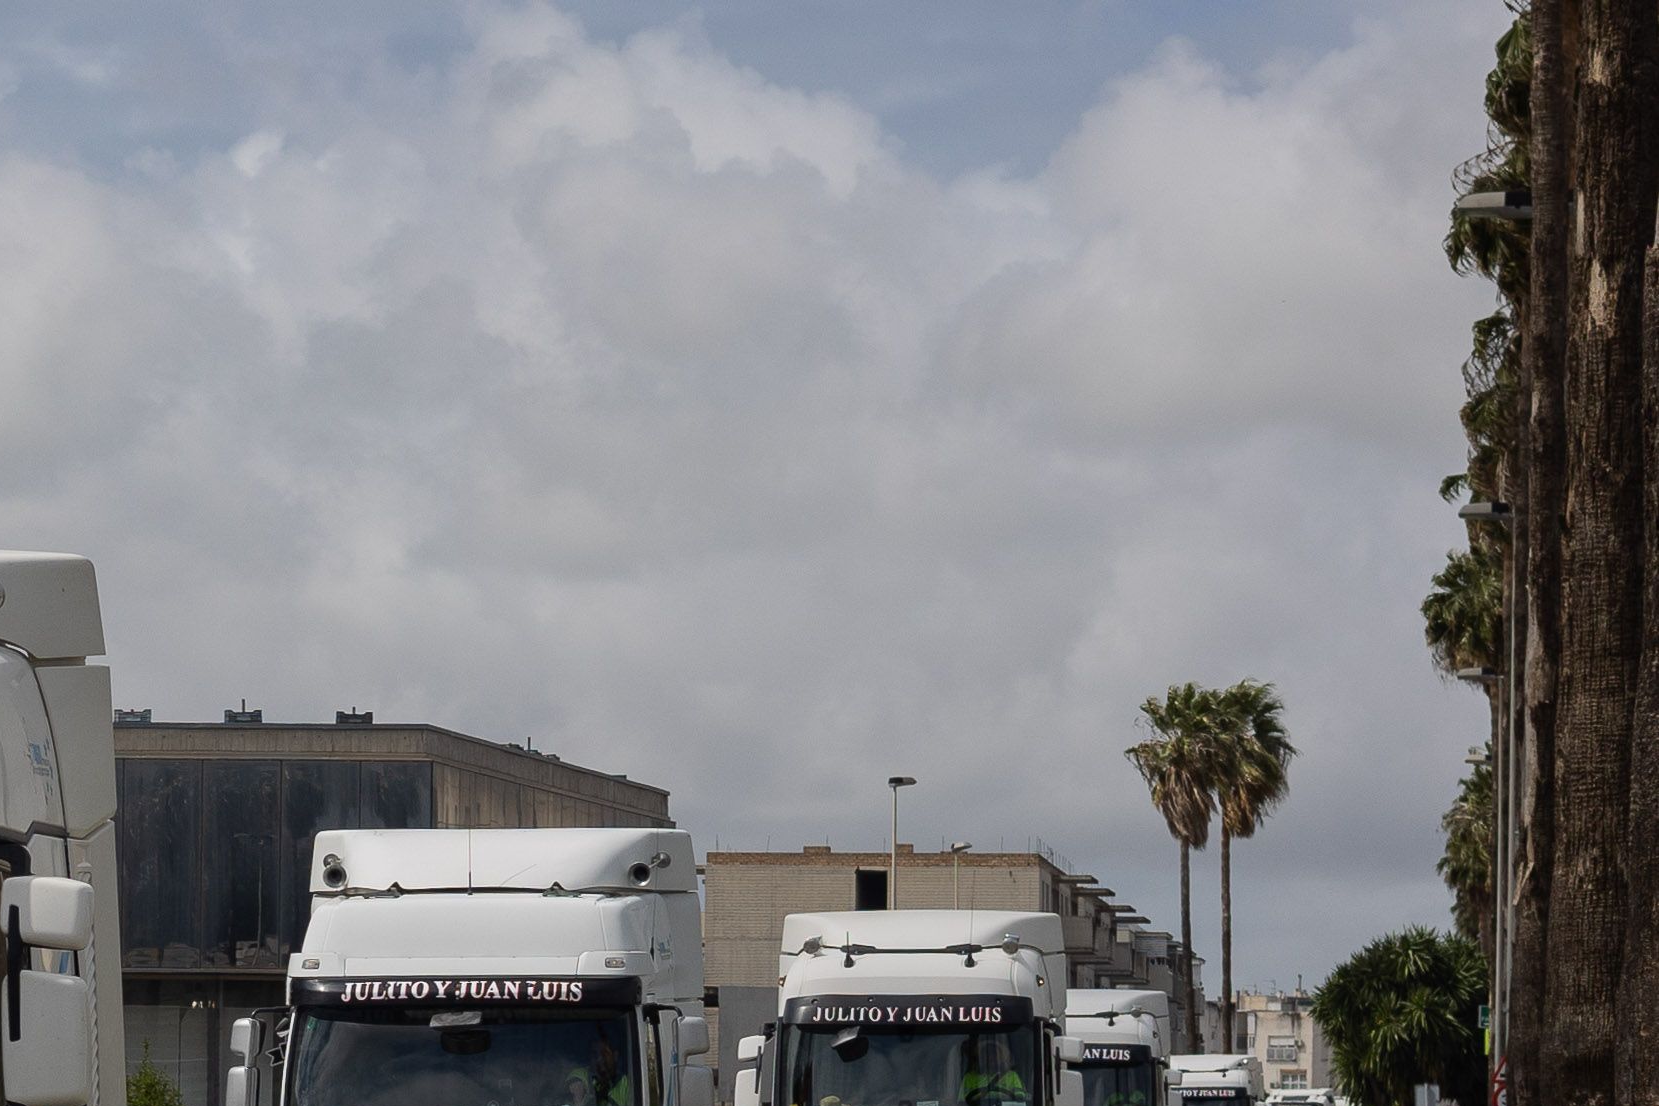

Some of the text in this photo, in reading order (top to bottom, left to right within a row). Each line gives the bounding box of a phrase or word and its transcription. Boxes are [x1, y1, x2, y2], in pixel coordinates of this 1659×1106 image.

[341, 980, 583, 1002] JULITO Y JUAN LUIS
[813, 1006, 1003, 1023] JULITO Y JUAN LUIS
[1083, 1048, 1131, 1061] AN LUIS
